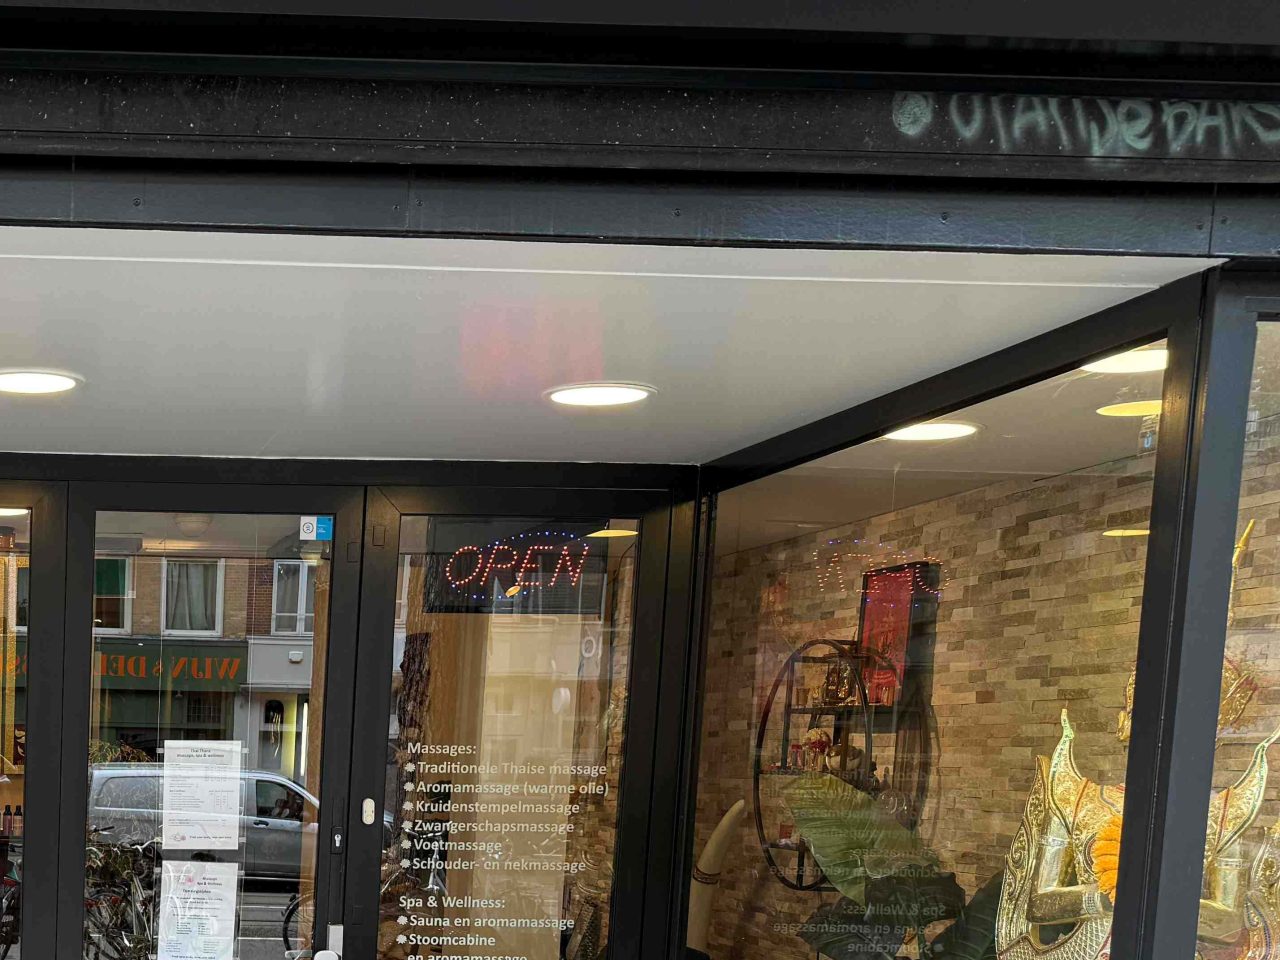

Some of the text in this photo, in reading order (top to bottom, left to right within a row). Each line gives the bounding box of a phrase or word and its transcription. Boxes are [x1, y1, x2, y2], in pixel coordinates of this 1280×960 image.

[446, 545, 589, 586] OPEN
[407, 743, 477, 757] Massages:
[418, 762, 607, 778] Traditionele Thaise massage
[416, 782, 609, 797] Aromamassage (warme olie)
[416, 800, 580, 815] Kruidenstempelmassage
[414, 820, 575, 834] Zwangerschapsmassage
[414, 839, 502, 853] Voetmassage
[412, 858, 586, 874] Schouder- en nekmassage
[399, 896, 505, 910] Spa & Wellness:
[410, 915, 575, 930] Sauna en aromamassage
[408, 934, 496, 946] Stoomcabine
